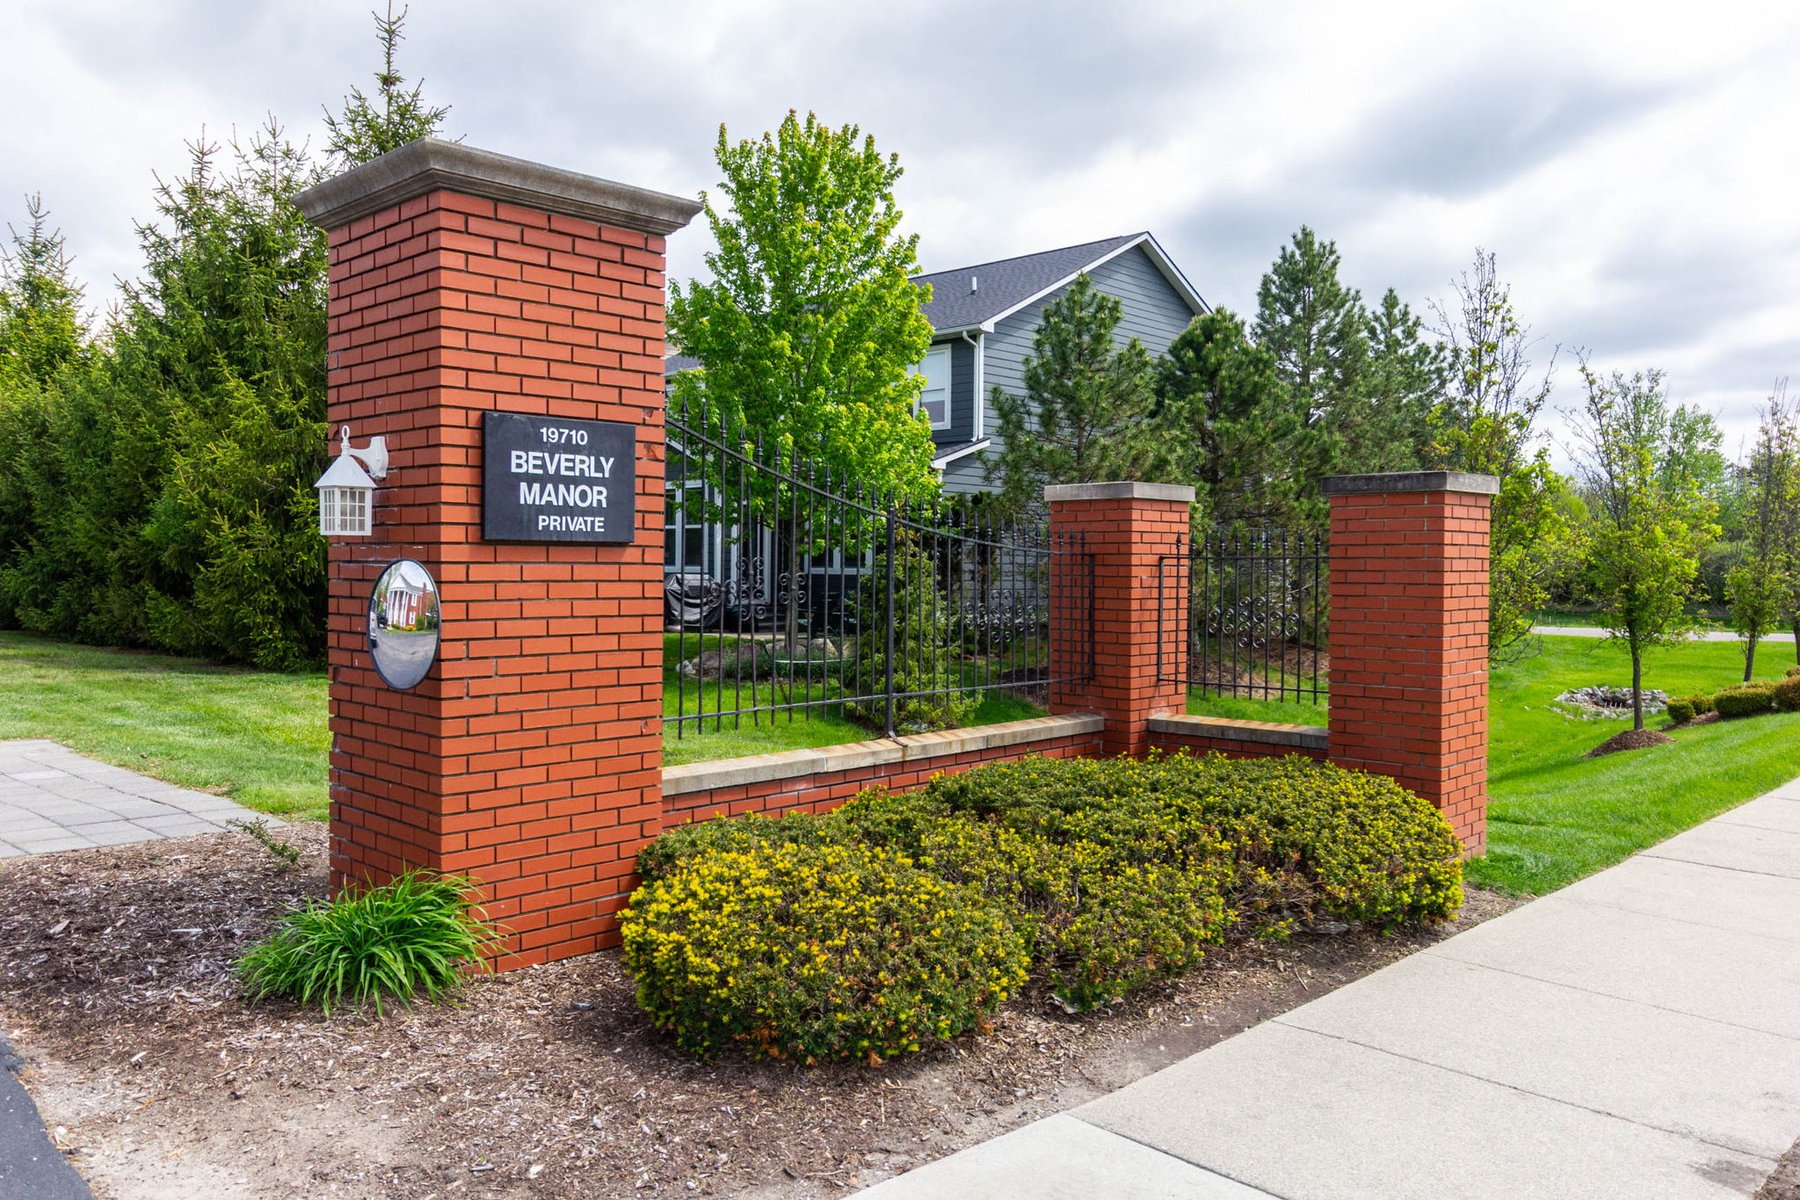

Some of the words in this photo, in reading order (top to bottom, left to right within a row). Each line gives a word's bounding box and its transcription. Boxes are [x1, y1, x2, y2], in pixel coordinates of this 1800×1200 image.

[540, 427, 588, 446] 19710
[510, 450, 615, 478] BEVERLY
[519, 482, 608, 508] MANOR
[538, 515, 605, 532] PRIVATE
